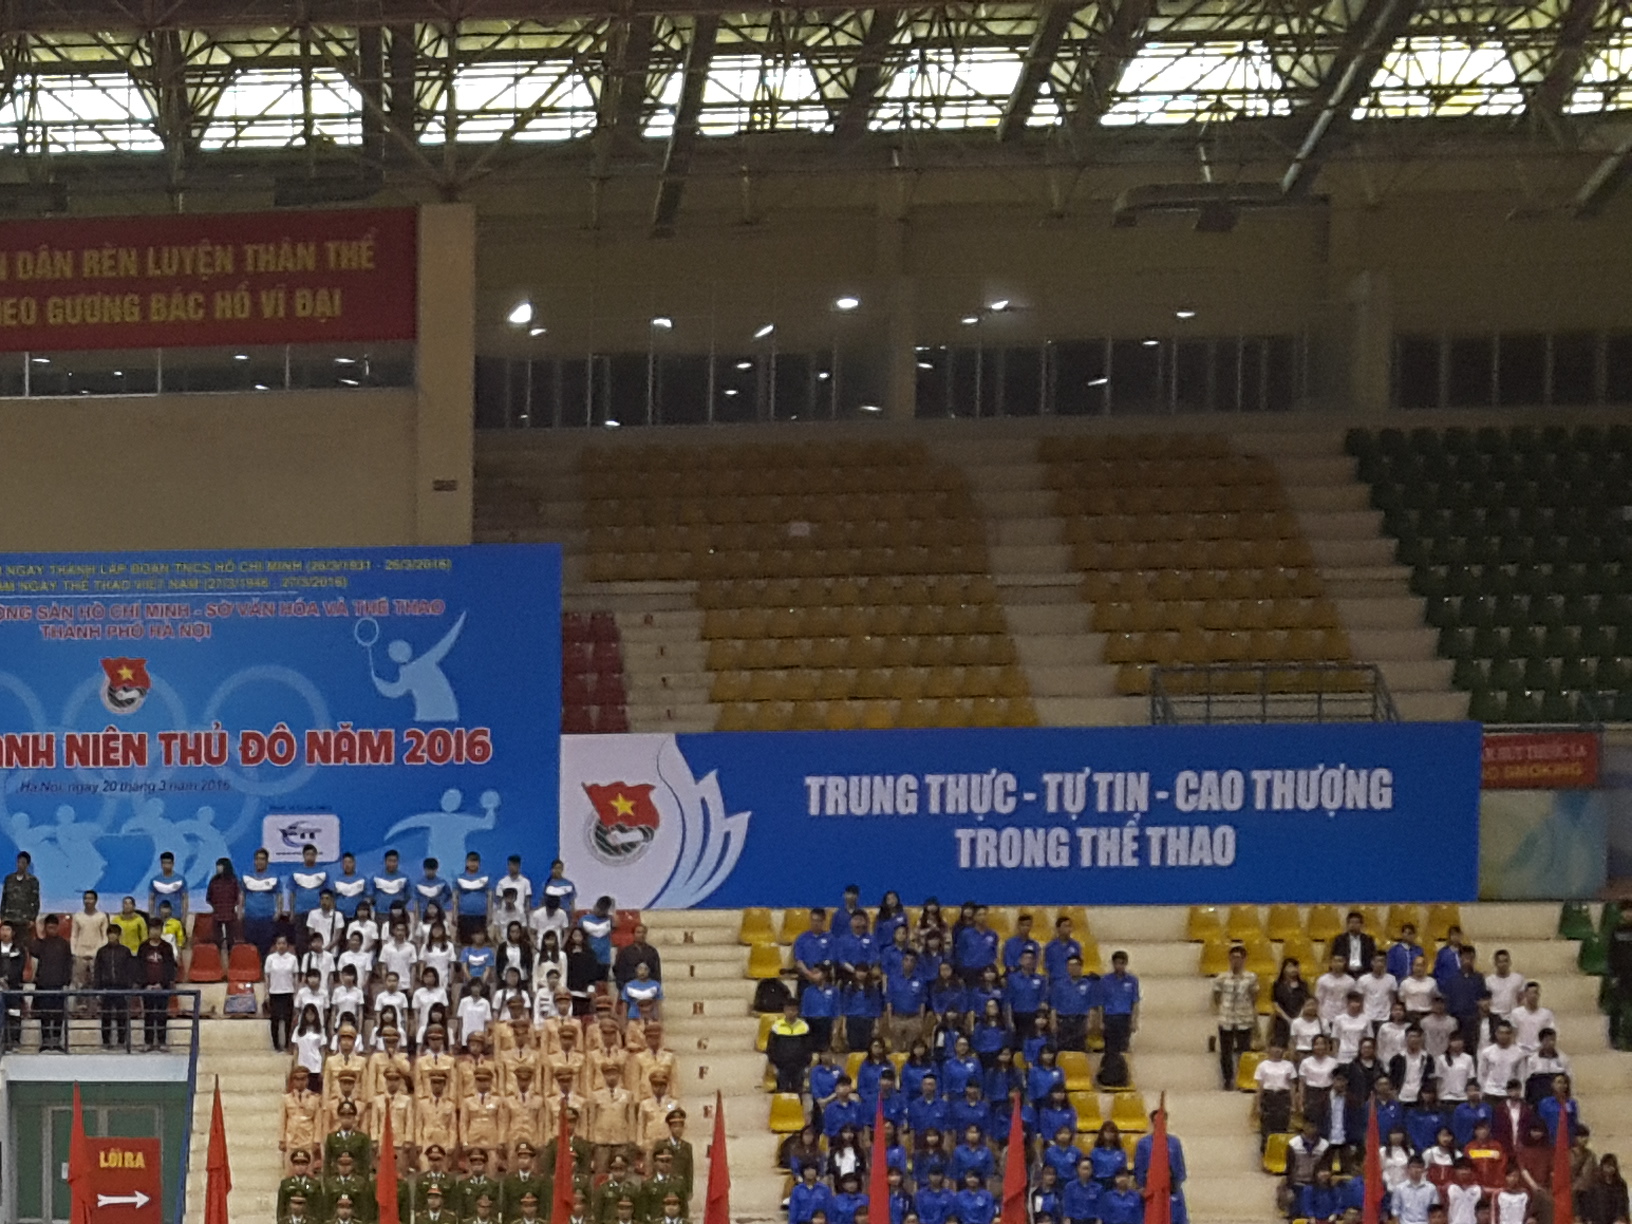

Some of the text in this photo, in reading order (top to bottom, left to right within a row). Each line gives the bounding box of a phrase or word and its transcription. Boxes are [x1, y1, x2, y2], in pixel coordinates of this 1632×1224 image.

[17, 243, 74, 281] DÂN
[82, 243, 138, 278] RÈN
[147, 238, 234, 282] LUYỆN
[244, 238, 317, 273] THÂN
[325, 226, 376, 271] THỂ
[47, 291, 140, 325] GƯƠNG
[150, 286, 205, 321] BÁC
[214, 281, 252, 318] HỒ
[261, 286, 286, 318] VĨ
[295, 287, 342, 325] ĐẠI
[37, 601, 74, 621] SẢN
[79, 600, 106, 621] HỒ
[109, 599, 143, 620] CHÍ
[145, 602, 192, 619] MINH
[237, 597, 277, 617] VĂN
[322, 596, 350, 617] VÀ
[354, 595, 390, 617] THỂ
[393, 598, 446, 616] THAO
[105, 619, 145, 639] PHỐ
[149, 618, 175, 638] HÀ
[179, 619, 212, 642] NỘI
[64, 723, 149, 768] NIÊN
[158, 721, 228, 767] THỦ
[239, 722, 297, 767] ĐÔ
[305, 721, 395, 766] NĂM
[403, 726, 493, 766] 2016
[103, 780, 118, 792] 20
[804, 773, 919, 816] TRUNG
[924, 768, 1017, 821] THỰC
[1042, 766, 1091, 821] TỰ
[1093, 772, 1150, 812] TIN
[1175, 769, 1245, 812] CAO
[1251, 763, 1393, 817] THƯỢNG
[954, 812, 1236, 869] TRONG THỂ THAO
[125, 1151, 146, 1169] RA
